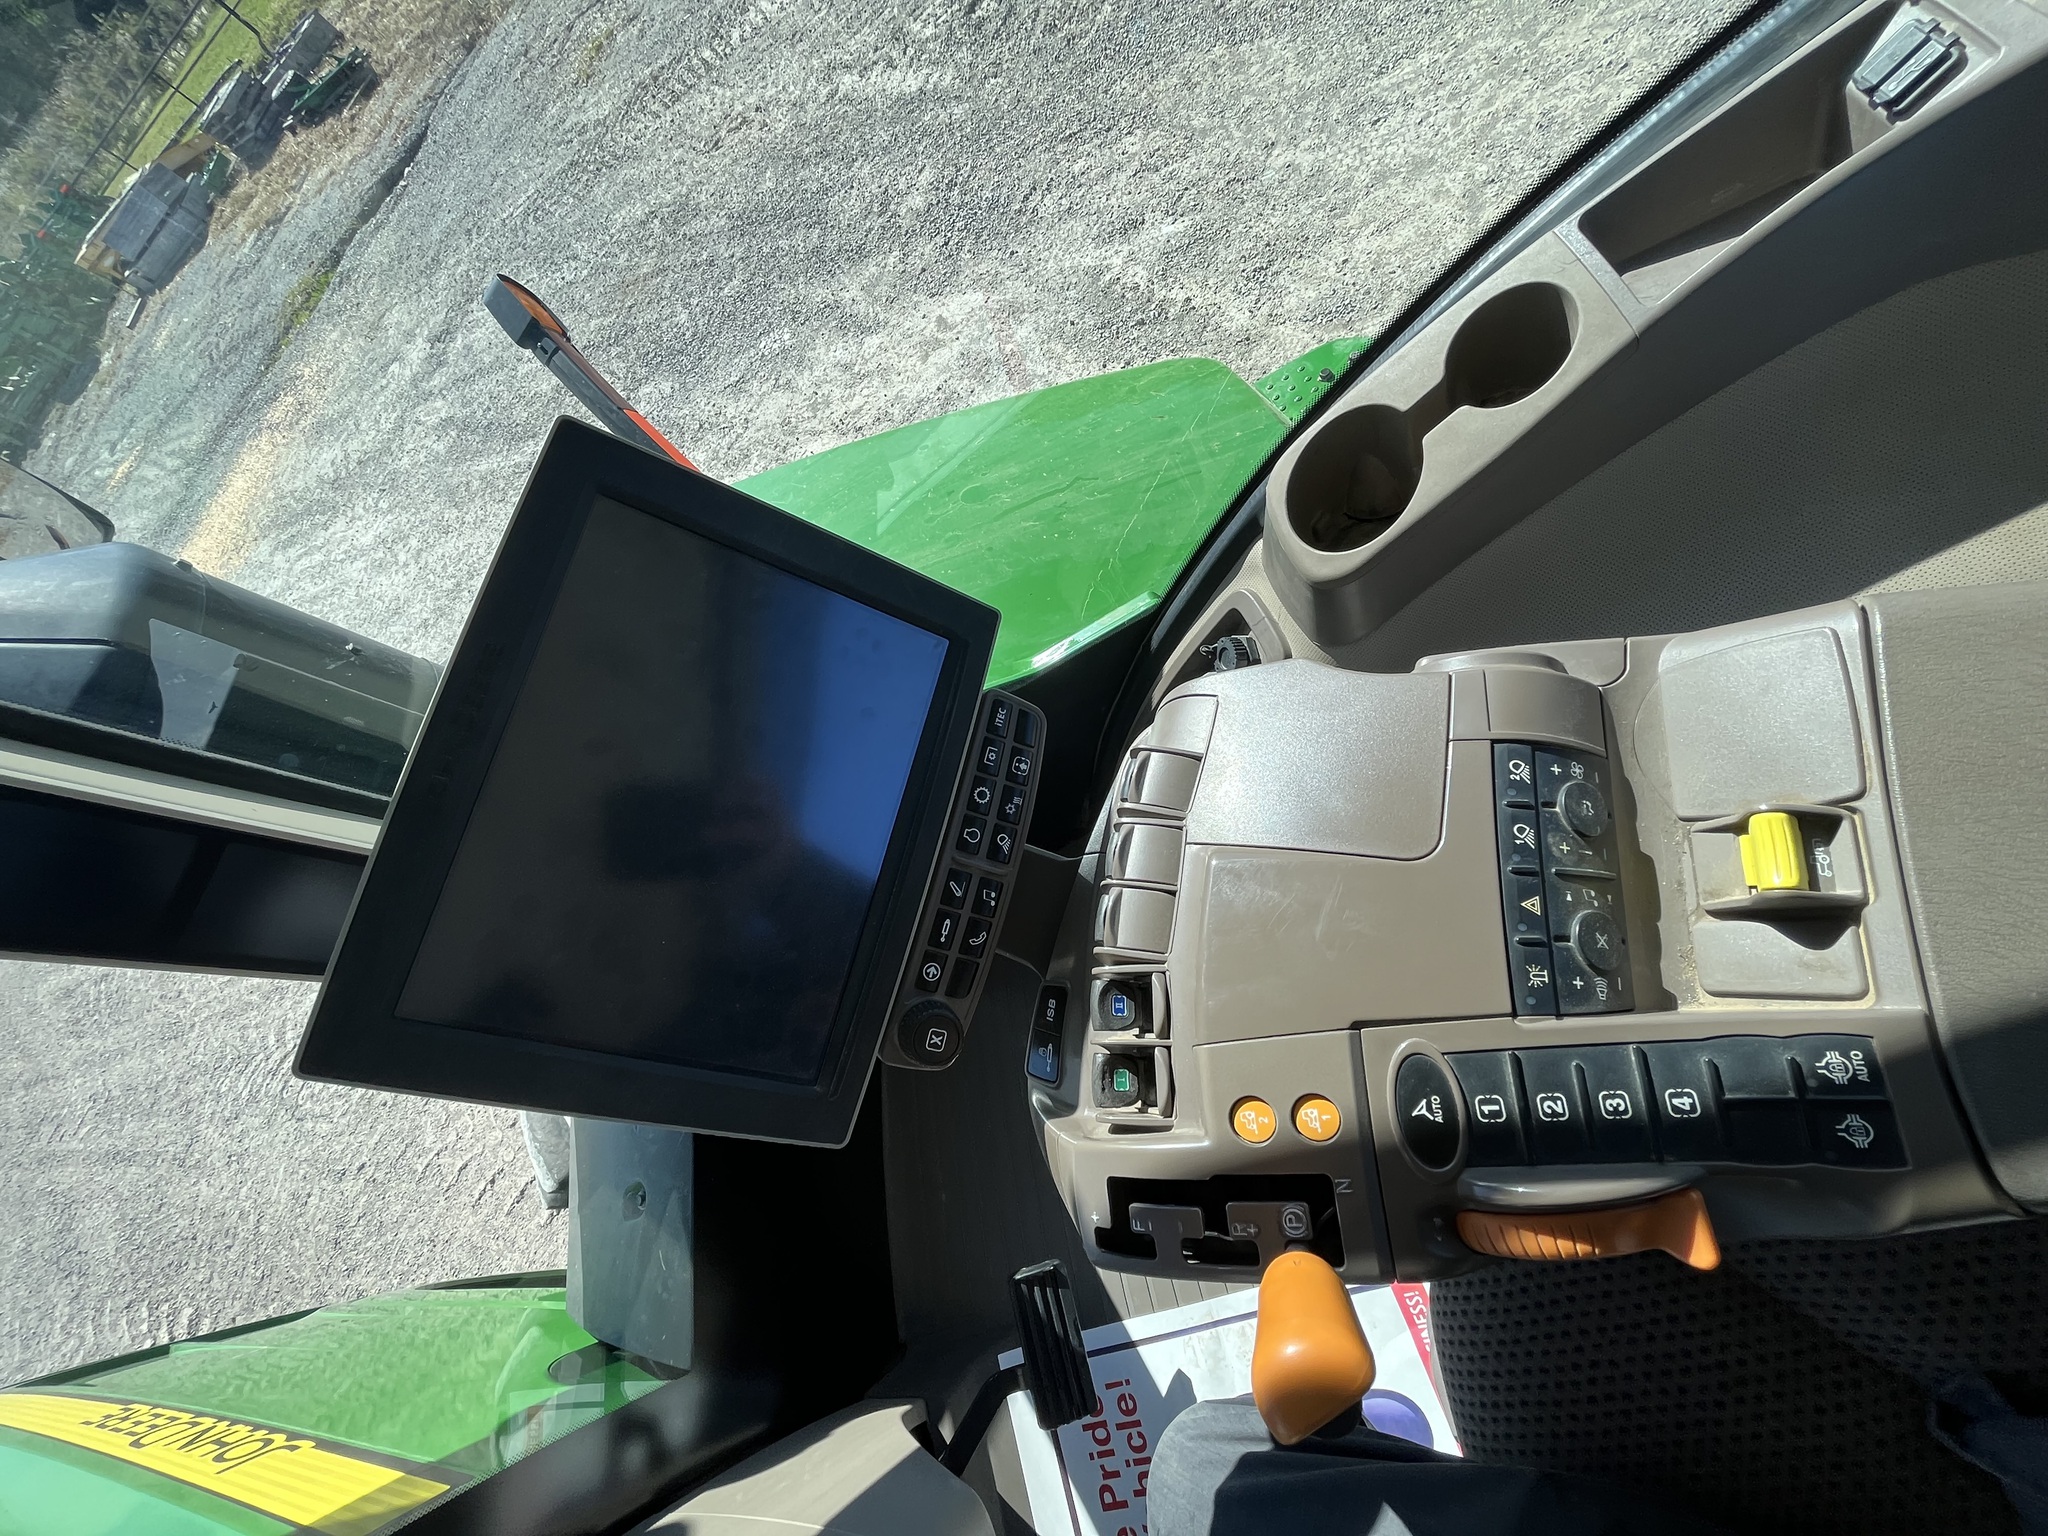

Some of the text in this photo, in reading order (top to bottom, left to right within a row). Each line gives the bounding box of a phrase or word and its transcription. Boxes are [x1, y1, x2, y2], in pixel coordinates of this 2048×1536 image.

[994, 707, 1007, 727] iTEC
[1046, 999, 1056, 1022] ISB
[1850, 1050, 1871, 1083] AUTO
[1430, 1095, 1444, 1123] AUTO
[1480, 1104, 1500, 1115] 1
[1542, 1099, 1562, 1114] 2
[1605, 1098, 1626, 1112] 3
[1671, 1096, 1694, 1111] 4
[1259, 1116, 1269, 1124] 2
[1286, 1214, 1303, 1228] P
[1104, 1378, 1152, 1533] hicle!
